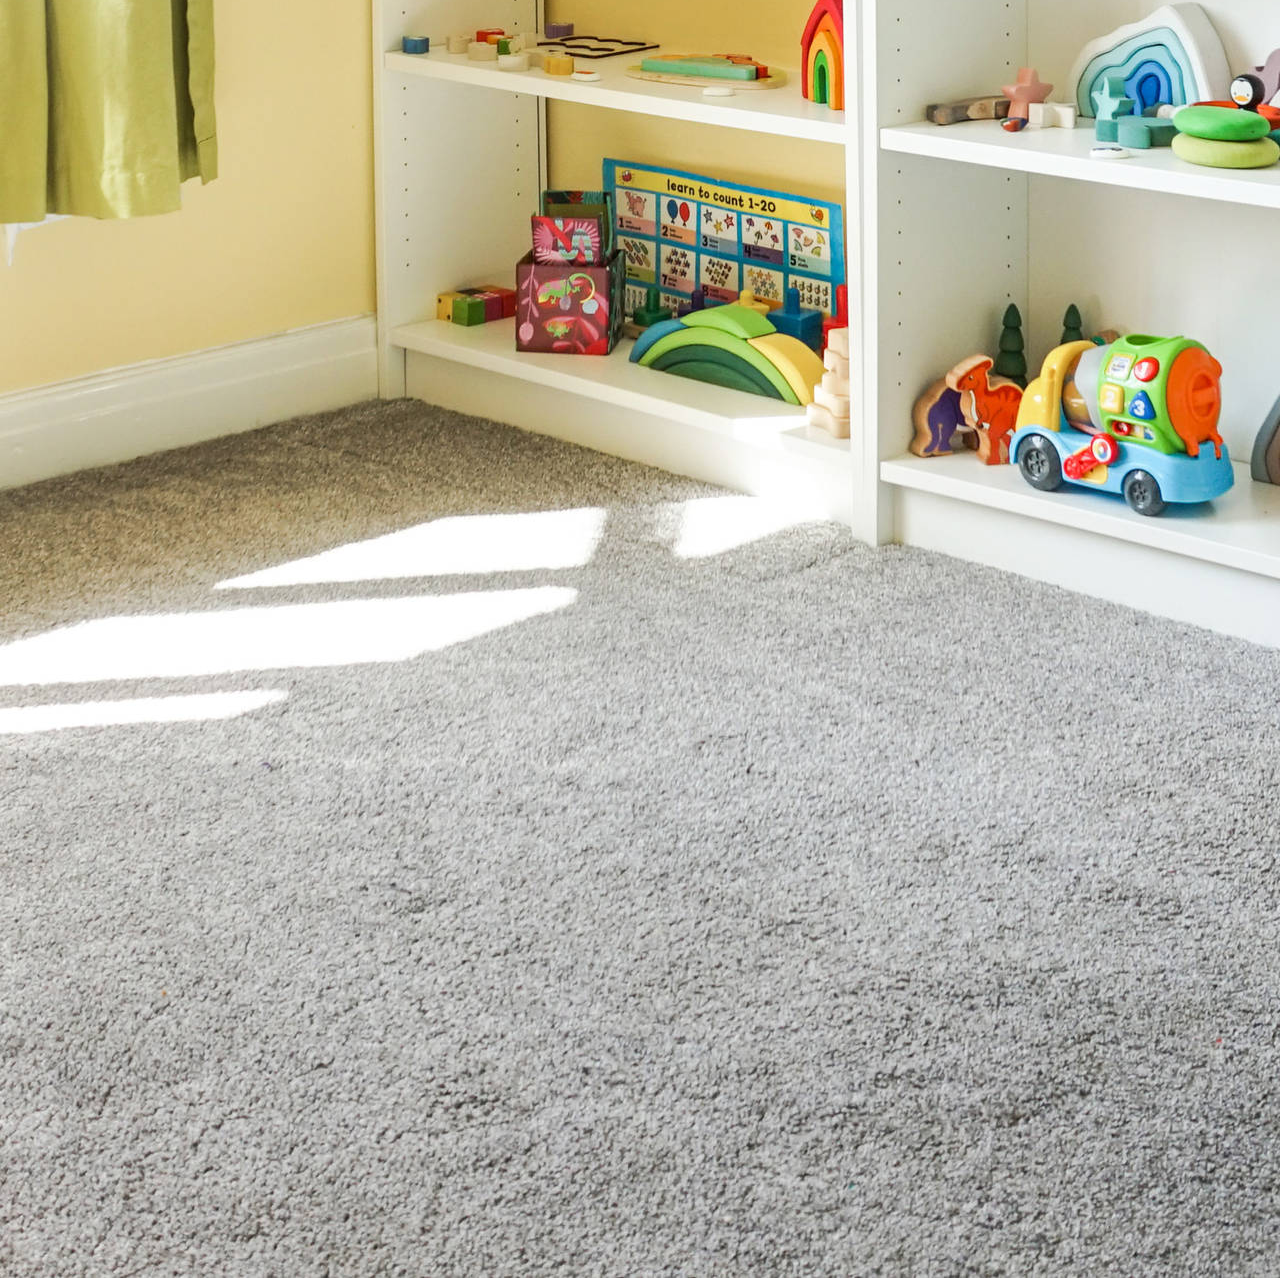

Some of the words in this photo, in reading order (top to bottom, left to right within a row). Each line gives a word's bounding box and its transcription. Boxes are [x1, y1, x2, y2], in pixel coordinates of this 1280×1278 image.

[667, 178, 695, 196] learn
[698, 185, 710, 199] to
[713, 190, 744, 208] count
[748, 197, 776, 213] 1-20
[619, 217, 625, 229] 1
[662, 226, 669, 238] 2
[702, 235, 708, 247] 3
[744, 243, 752, 258] 4
[790, 254, 797, 266] 5
[662, 274, 668, 286] 7
[702, 284, 709, 297] 8
[1137, 361, 1149, 379] 1
[1105, 390, 1116, 406] 2
[1133, 399, 1145, 417] 3
